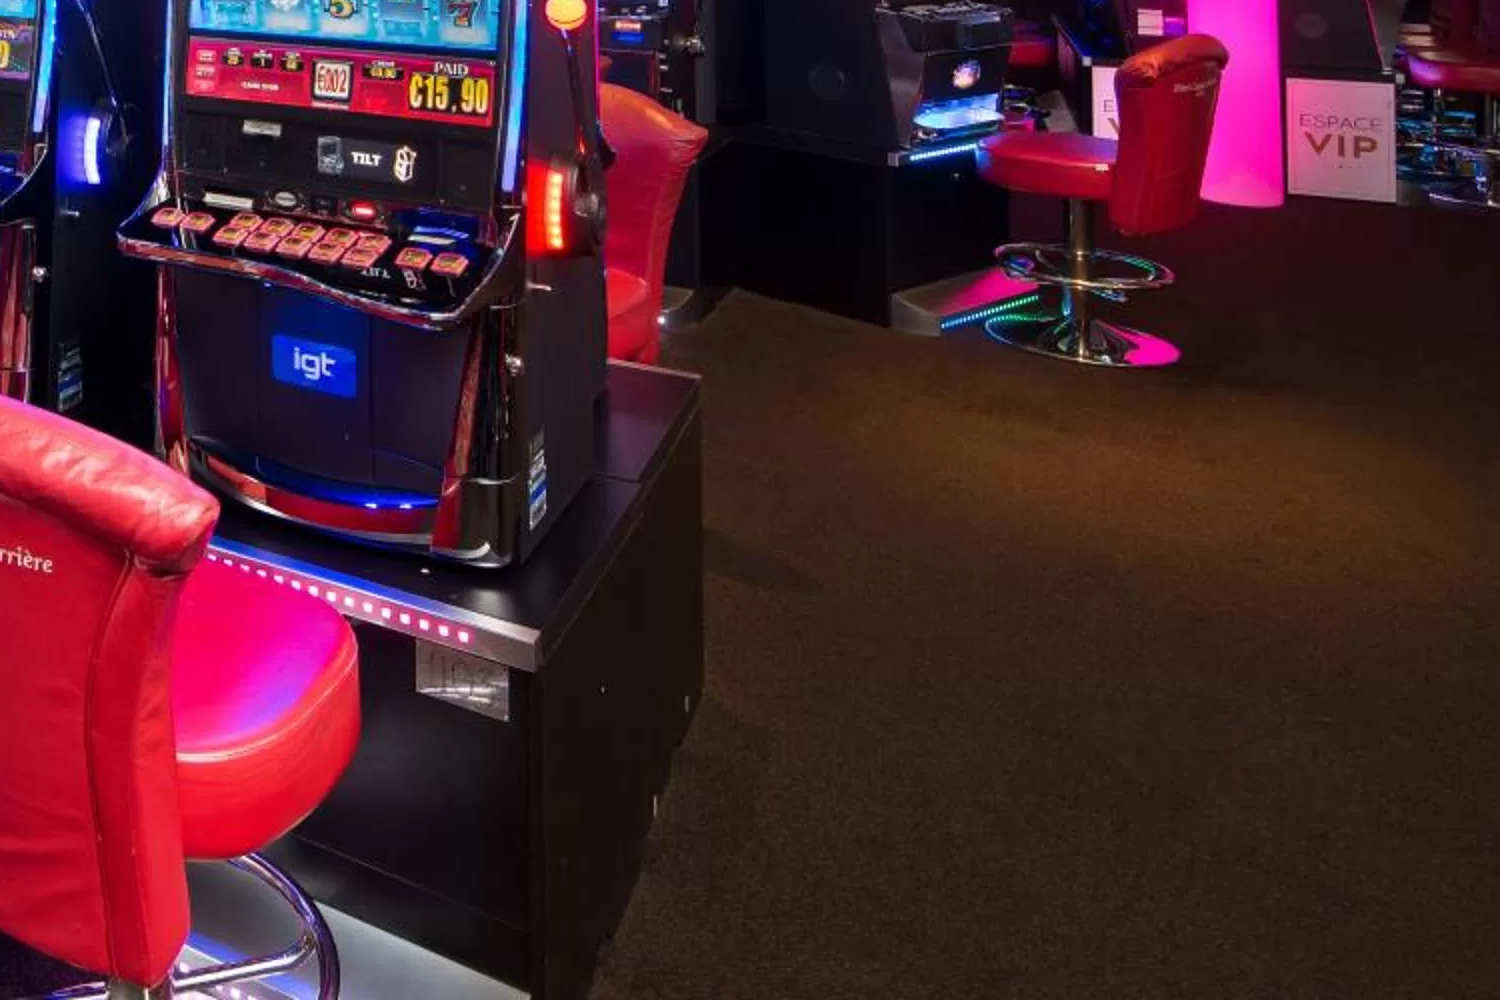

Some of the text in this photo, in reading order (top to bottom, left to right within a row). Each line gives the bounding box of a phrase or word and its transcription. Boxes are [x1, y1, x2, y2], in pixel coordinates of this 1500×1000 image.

[434, 62, 469, 76] PAID
[1299, 113, 1384, 133] ESPACE
[1303, 131, 1378, 159] VIP
[351, 151, 383, 167] TILT
[292, 347, 336, 381] igt
